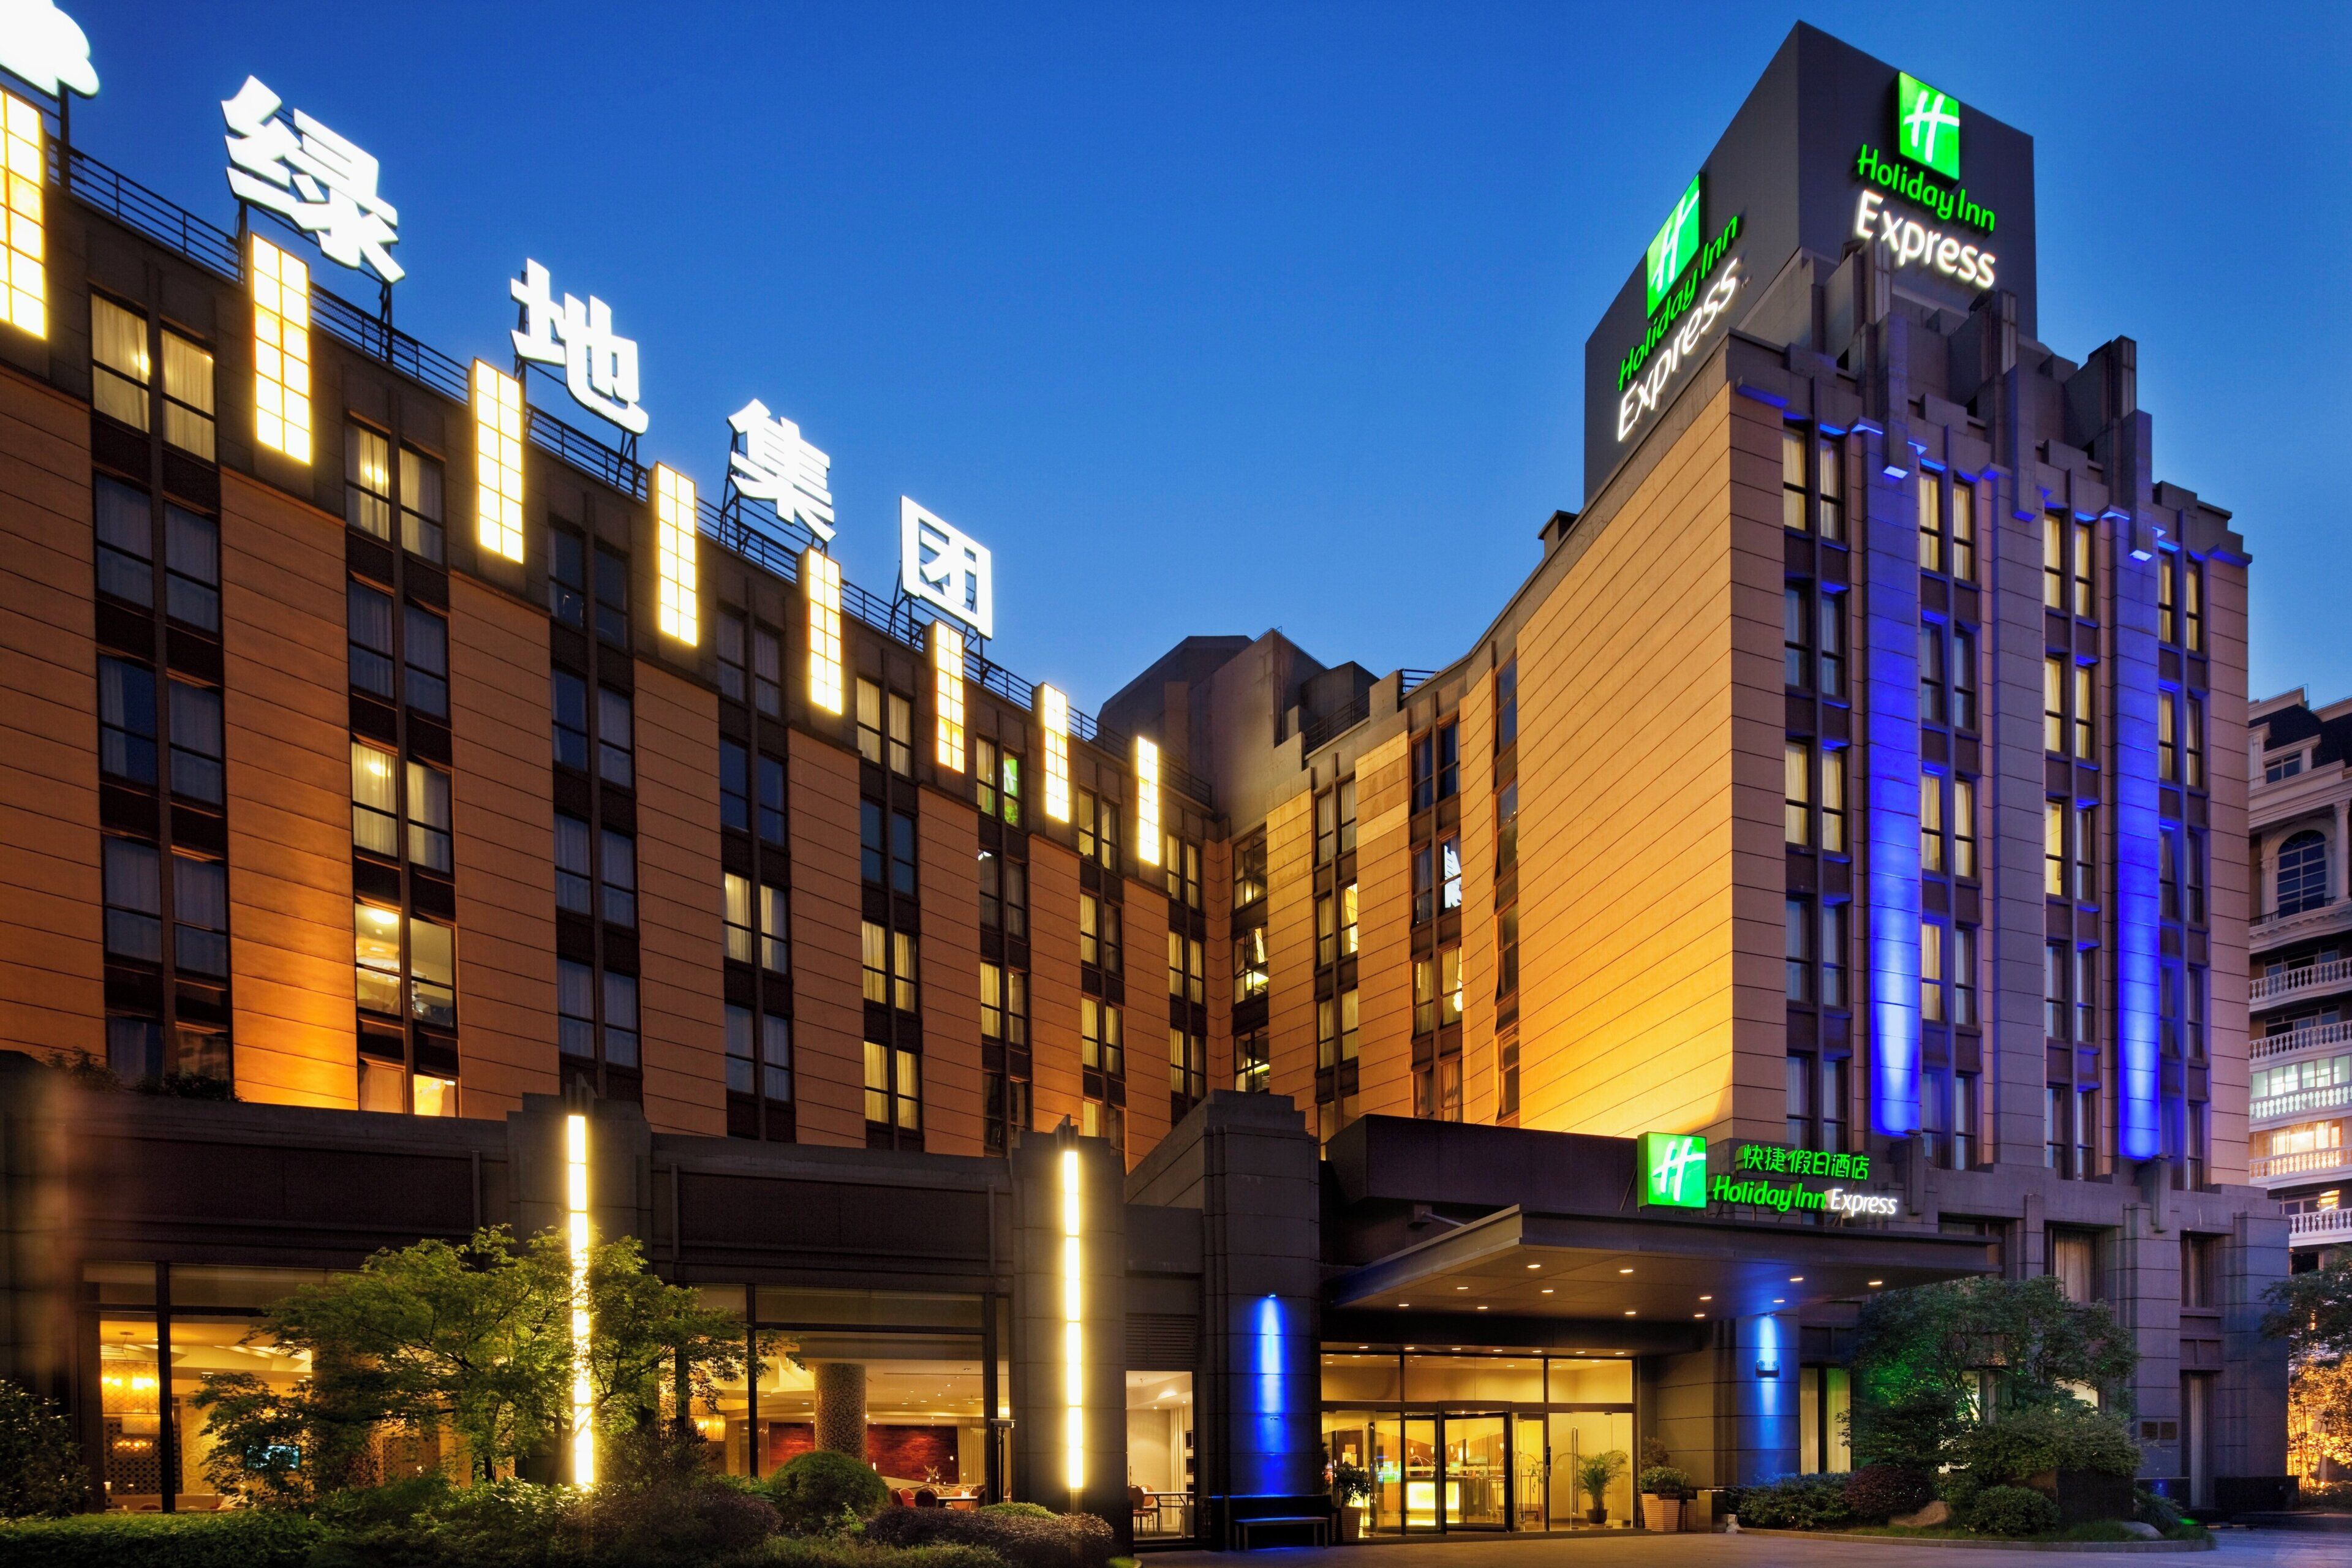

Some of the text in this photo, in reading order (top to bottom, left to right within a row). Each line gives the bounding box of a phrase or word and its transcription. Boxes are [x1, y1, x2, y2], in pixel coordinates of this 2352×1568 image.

[1858, 144, 1995, 232] Holiday Inn
[1856, 190, 1996, 288] Express
[1618, 216, 1738, 391] Holiday Inn
[1618, 257, 1738, 442] Express
[221, 75, 993, 639] 绿地集团
[1713, 1175, 1898, 1217] Holiday Inn Express
[1743, 1144, 1869, 1180] 快捷假日酒店
